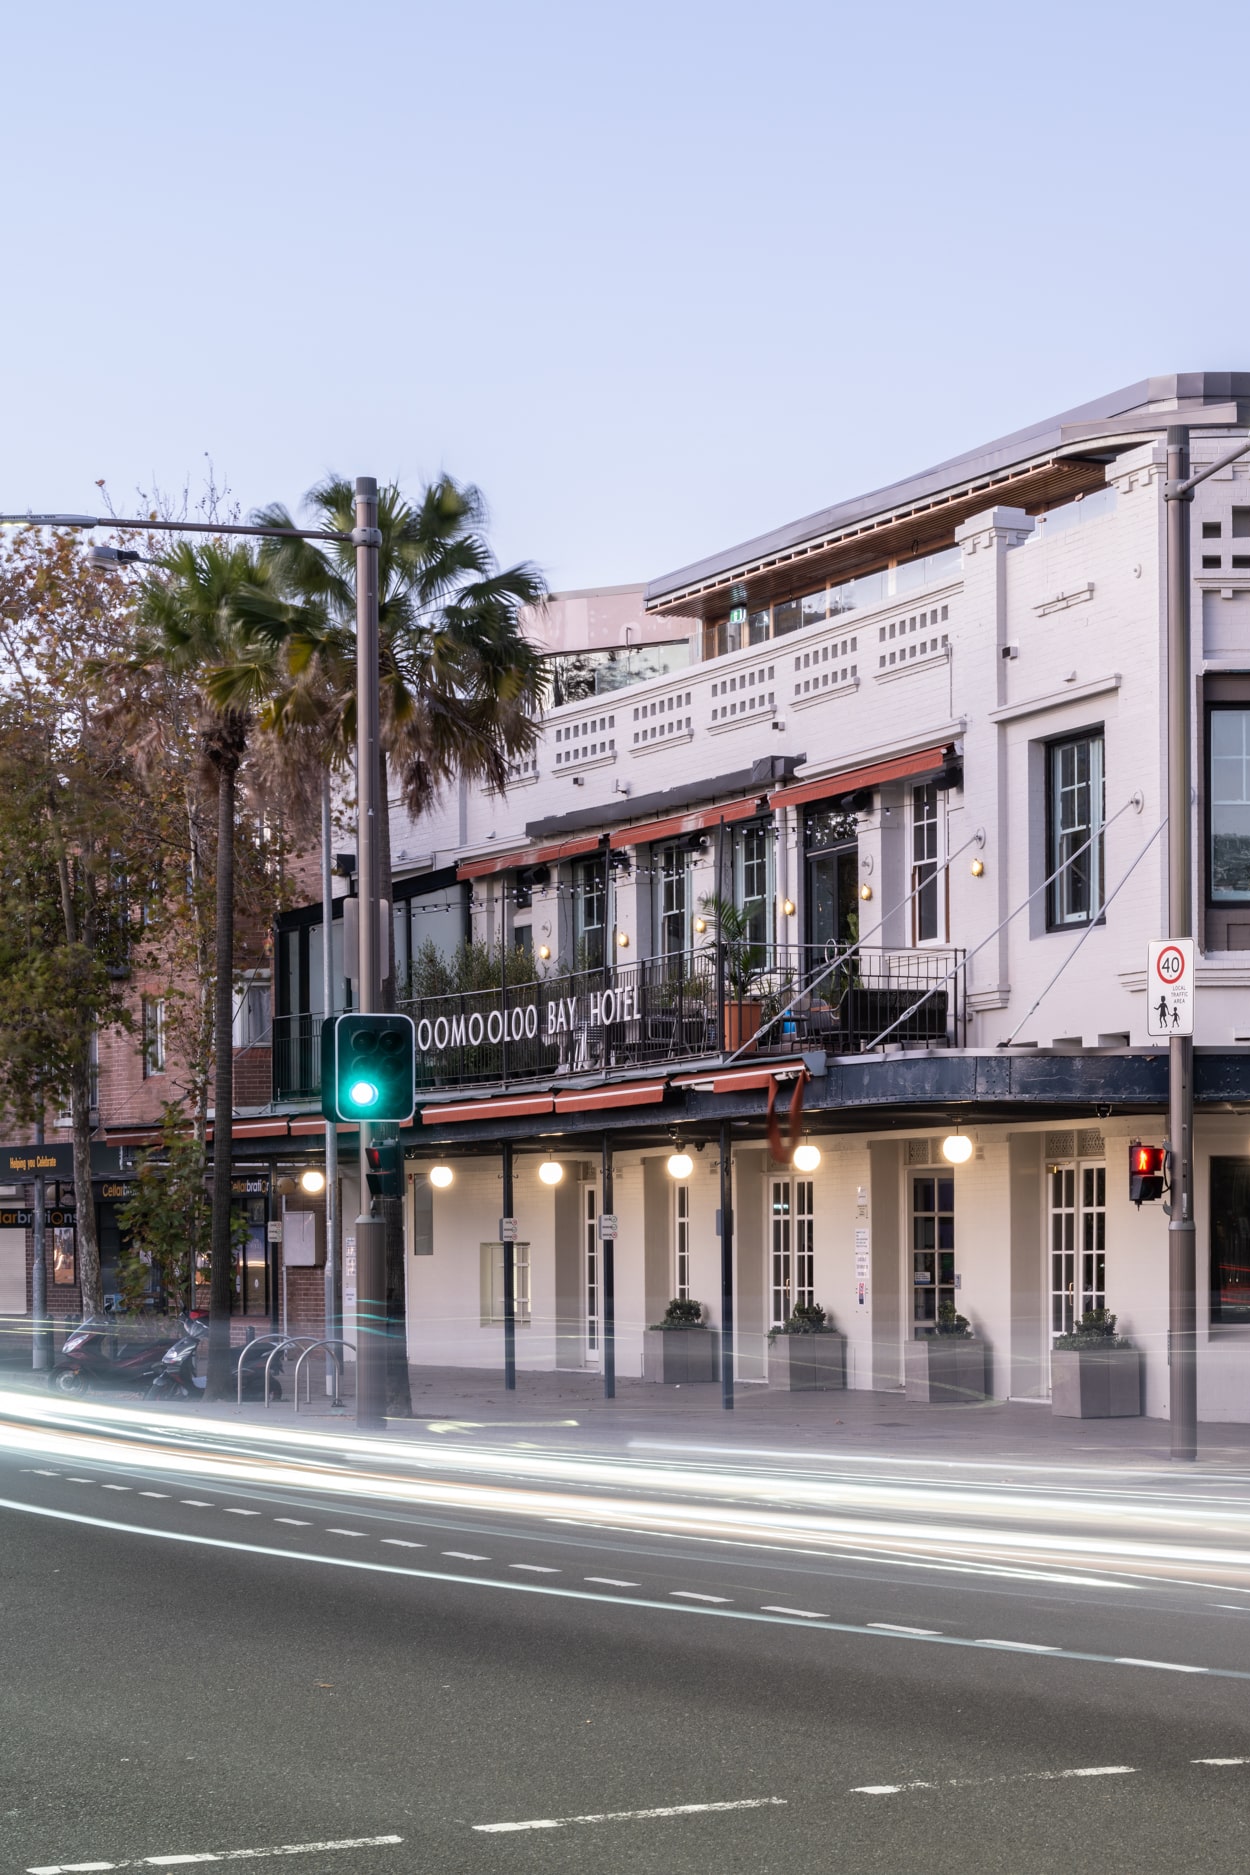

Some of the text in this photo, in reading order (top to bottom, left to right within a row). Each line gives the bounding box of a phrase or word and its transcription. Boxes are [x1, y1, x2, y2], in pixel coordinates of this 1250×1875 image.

[1161, 957, 1180, 973] 40
[548, 996, 577, 1035] BAY
[590, 984, 642, 1027] HOTEL
[9, 1155, 57, 1172] Helping you Celebrate
